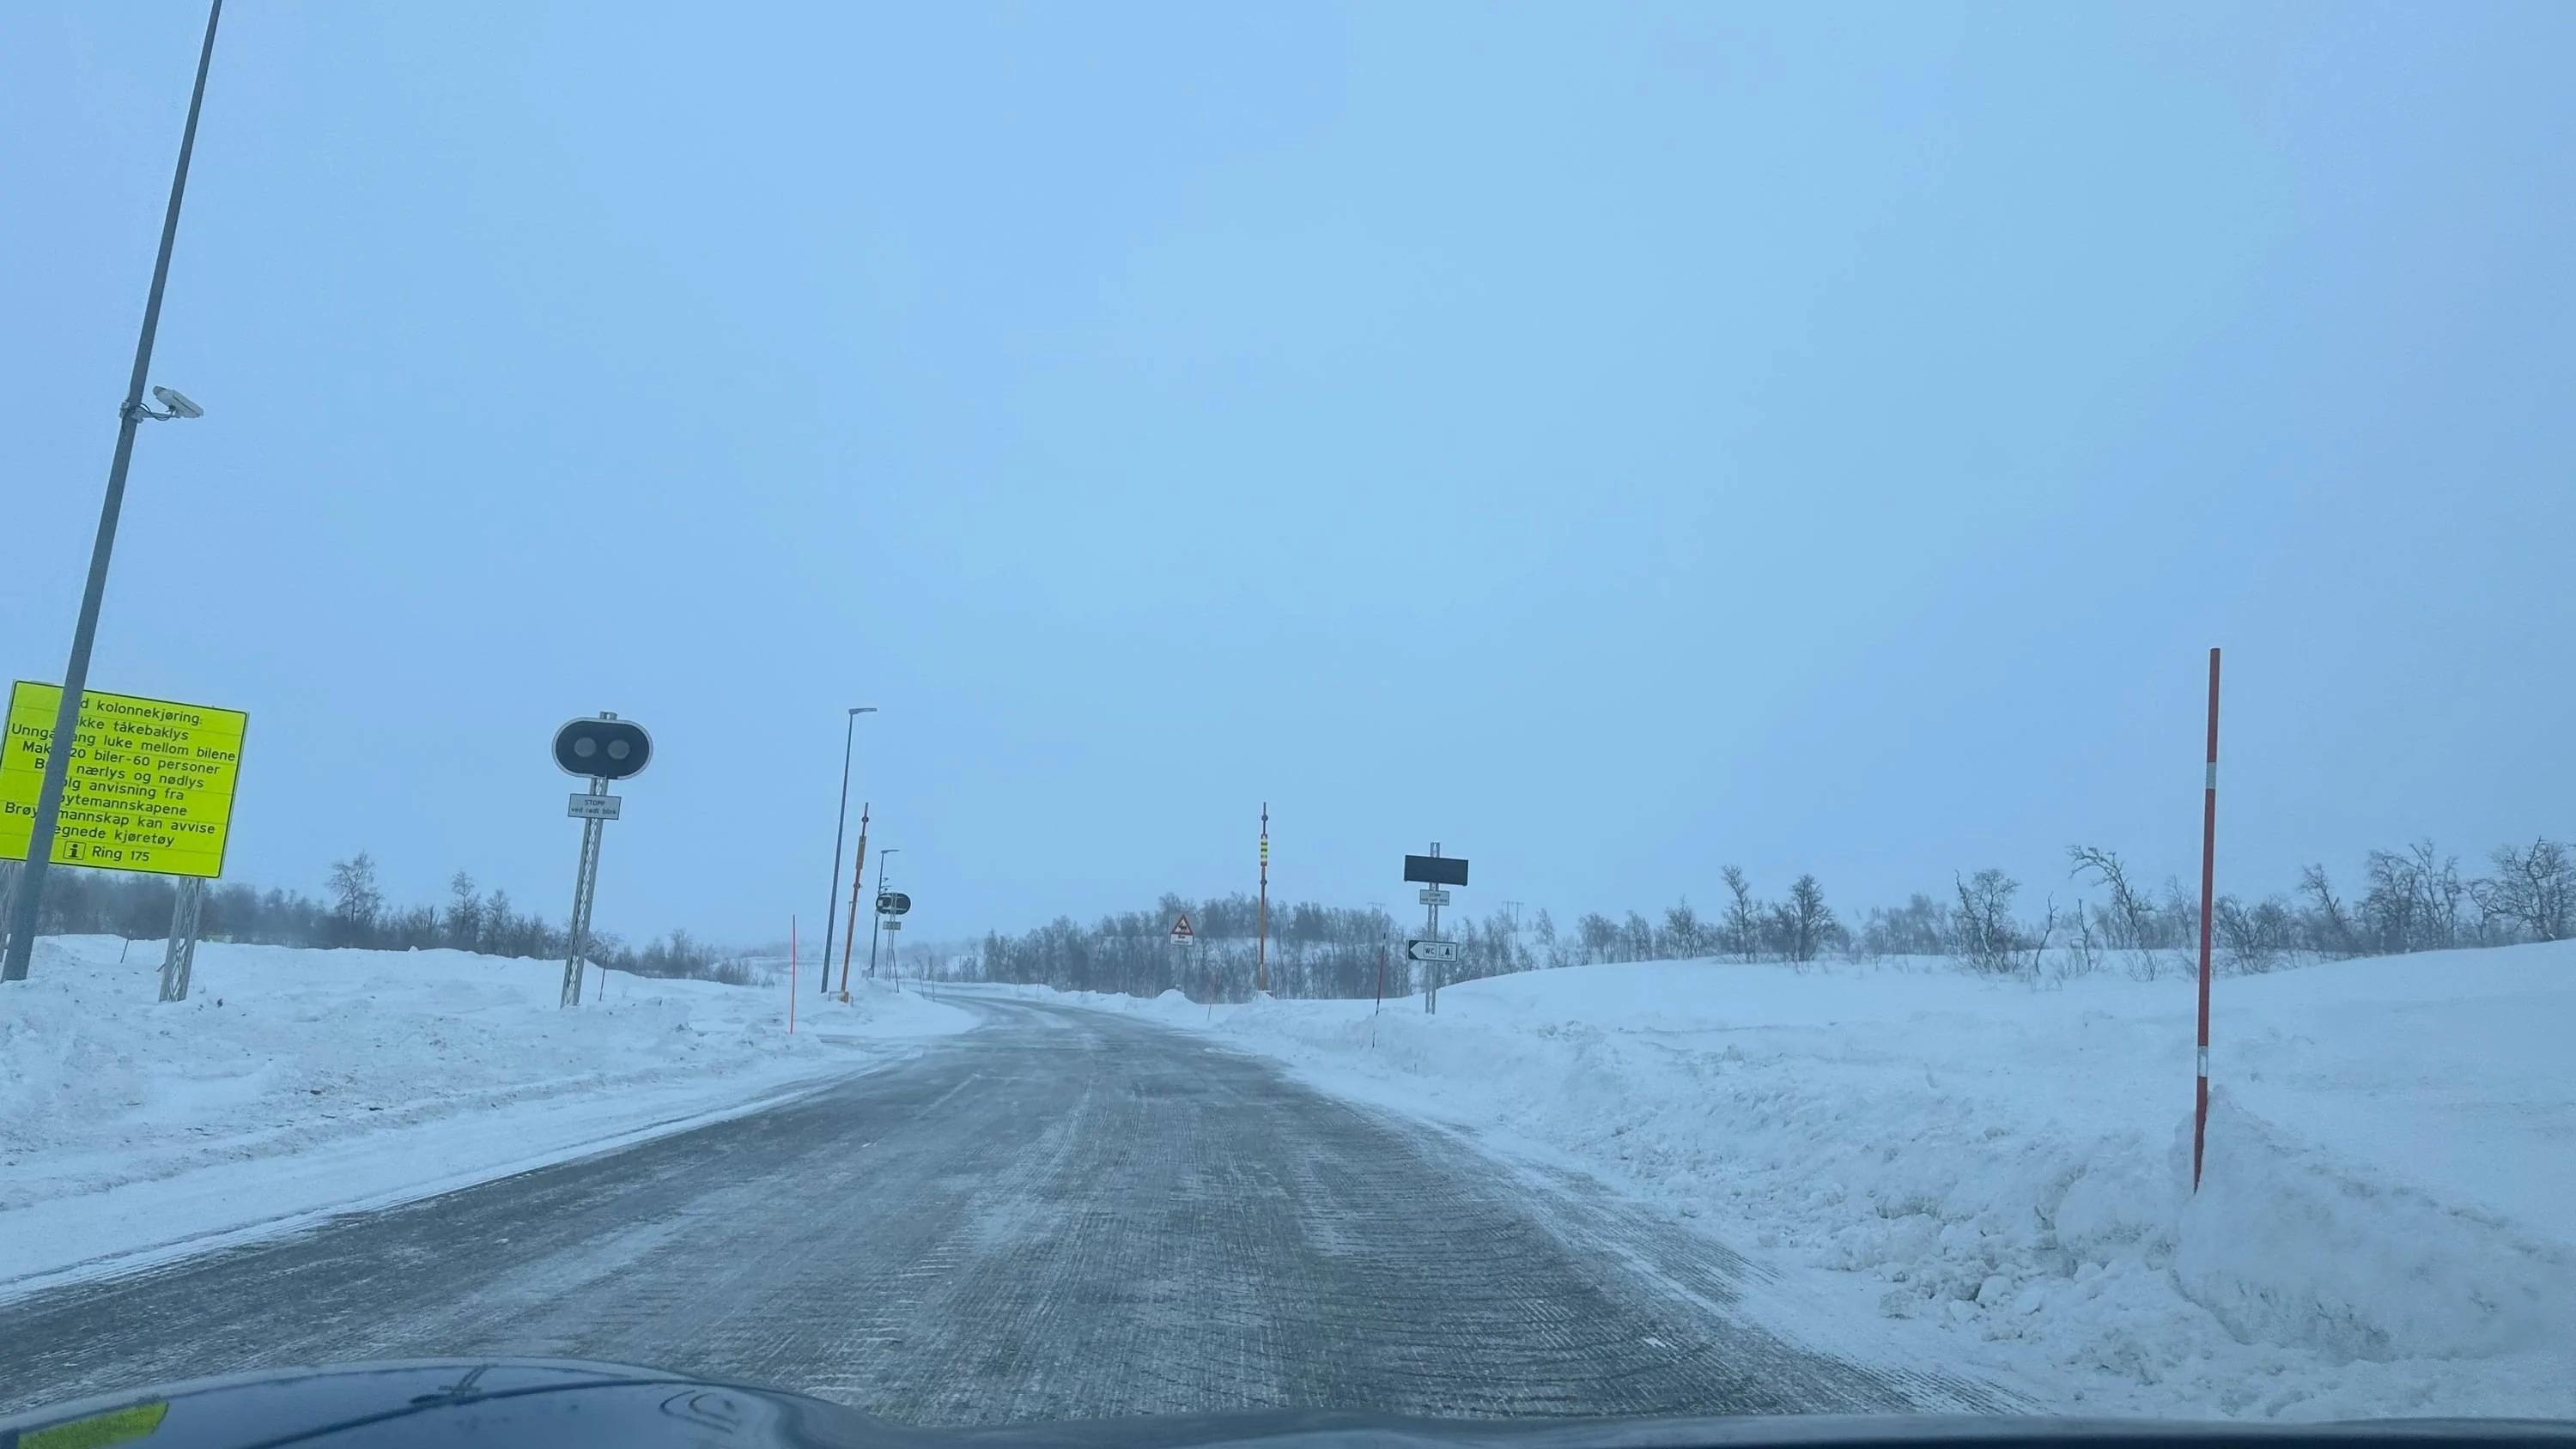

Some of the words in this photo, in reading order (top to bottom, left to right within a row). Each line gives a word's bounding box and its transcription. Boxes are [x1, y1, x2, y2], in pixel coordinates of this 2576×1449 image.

[114, 720, 189, 741] tåkebaklys
[104, 735, 132, 749] luke
[141, 742, 189, 755] mellom
[197, 747, 236, 761] bilene
[158, 760, 221, 774] personer
[76, 765, 125, 780] nærlys
[134, 773, 151, 784] og
[159, 775, 204, 789] nødlys
[89, 782, 156, 799] anvisning
[165, 788, 184, 800] fra
[137, 816, 162, 828] kan
[171, 821, 216, 834] avvise
[54, 825, 106, 839] egnede
[114, 829, 174, 847] kjøretøy
[92, 846, 122, 862] Ring
[131, 851, 150, 862] 175
